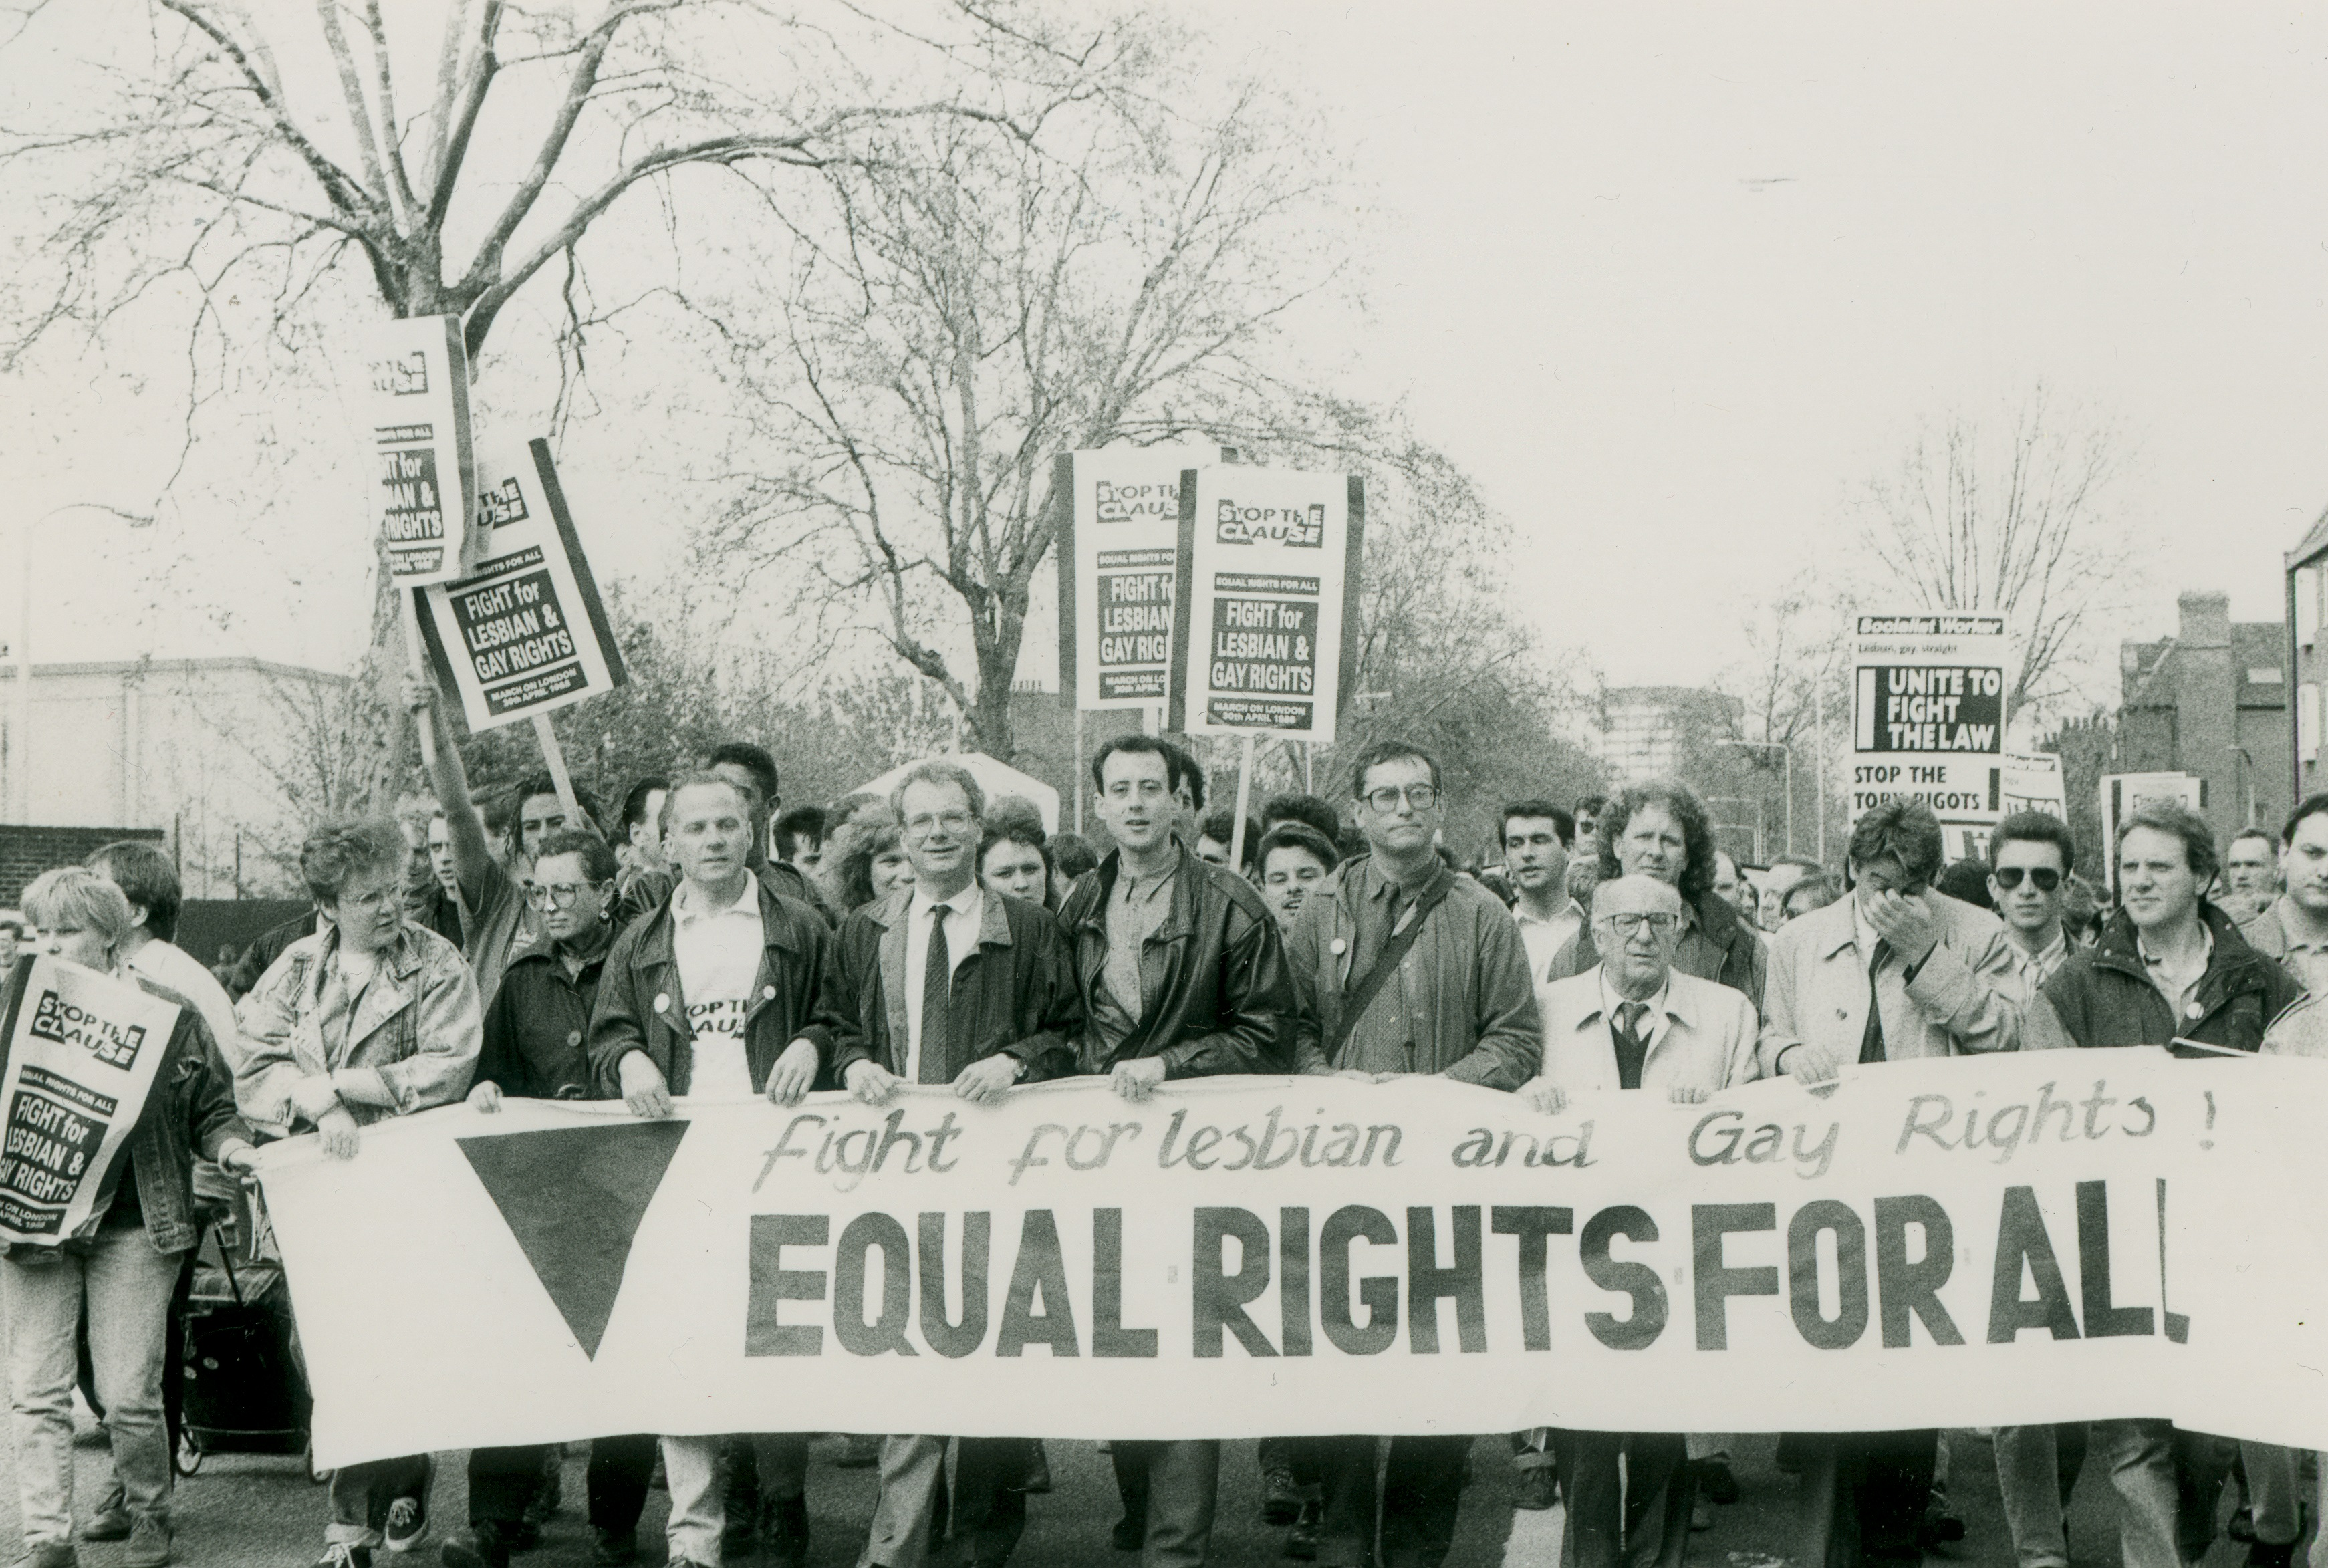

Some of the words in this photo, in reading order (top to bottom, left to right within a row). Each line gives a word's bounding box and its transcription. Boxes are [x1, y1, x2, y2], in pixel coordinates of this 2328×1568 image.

[399, 451, 422, 477] for
[420, 481, 435, 506] &
[1097, 485, 1152, 502] STOP
[1098, 501, 1179, 519] CLAUS
[1219, 504, 1277, 523] STOP
[1280, 508, 1322, 525] THE
[1218, 522, 1321, 543] CLAUSE
[524, 550, 542, 563] ALL
[1160, 552, 1174, 561] FO
[1111, 575, 1159, 603] FIGHT
[1216, 577, 1247, 587] EQUAL
[1247, 578, 1279, 589] RIGHTS
[1281, 579, 1299, 590] FOR
[1299, 581, 1318, 591] ALL
[465, 584, 513, 621] FIGHT
[514, 580, 540, 606] for
[467, 608, 541, 652] LESBIAN
[541, 603, 560, 628] &
[1104, 605, 1170, 633] LESBIAN
[1226, 600, 1277, 628] FIGHT
[1278, 603, 1303, 630] for
[1939, 617, 2001, 635] Worker
[475, 648, 509, 680] GAY
[509, 629, 573, 671] RIGHTS
[1101, 636, 1135, 662] GAY
[1217, 631, 1289, 660] LESBIAN
[1295, 634, 1310, 661] &
[491, 685, 523, 702] MARCH
[522, 680, 538, 694] ON
[537, 667, 577, 688] LONDON
[1138, 674, 1154, 684] ON
[1212, 661, 1249, 688] GAY
[1249, 663, 1313, 692] RIGHTS
[1888, 668, 1964, 696] UNITE
[1968, 668, 2001, 697] TO
[521, 687, 549, 704] APRIL
[1214, 702, 1249, 712] MARCH
[1249, 704, 1264, 714] ON
[1265, 704, 1307, 716] LONDON
[1888, 696, 1962, 723] FIGHT
[1244, 712, 1273, 723] APRIL
[1888, 723, 1936, 749] THE
[1938, 723, 1996, 751] LAW
[1854, 765, 1902, 784] STOP
[1908, 766, 1947, 784] THE
[39, 995, 98, 1027] STOP
[101, 1019, 143, 1049] THE
[34, 1015, 136, 1065] CLAUSE
[44, 1076, 77, 1097] RIGHTS
[76, 1090, 96, 1106] FOR
[94, 1099, 113, 1113] ALL
[15, 1094, 66, 1134] FIGHT
[60, 1113, 90, 1145] for
[1007, 1120, 1143, 1187] for
[1158, 1105, 1404, 1171] lesbian
[1451, 1118, 1600, 1169] and
[1687, 1109, 1841, 1180] Gay
[1894, 1077, 2157, 1166] Rights
[6, 1126, 68, 1172] LESBIAN
[68, 1151, 84, 1176] &
[13, 1162, 78, 1201] RIGHTS
[5, 1202, 20, 1215] ON
[19, 1208, 59, 1222] LONDON
[745, 1206, 1160, 1359] EQUAL
[1192, 1204, 1669, 1359] RIGHTS
[1691, 1193, 1967, 1352] FOR
